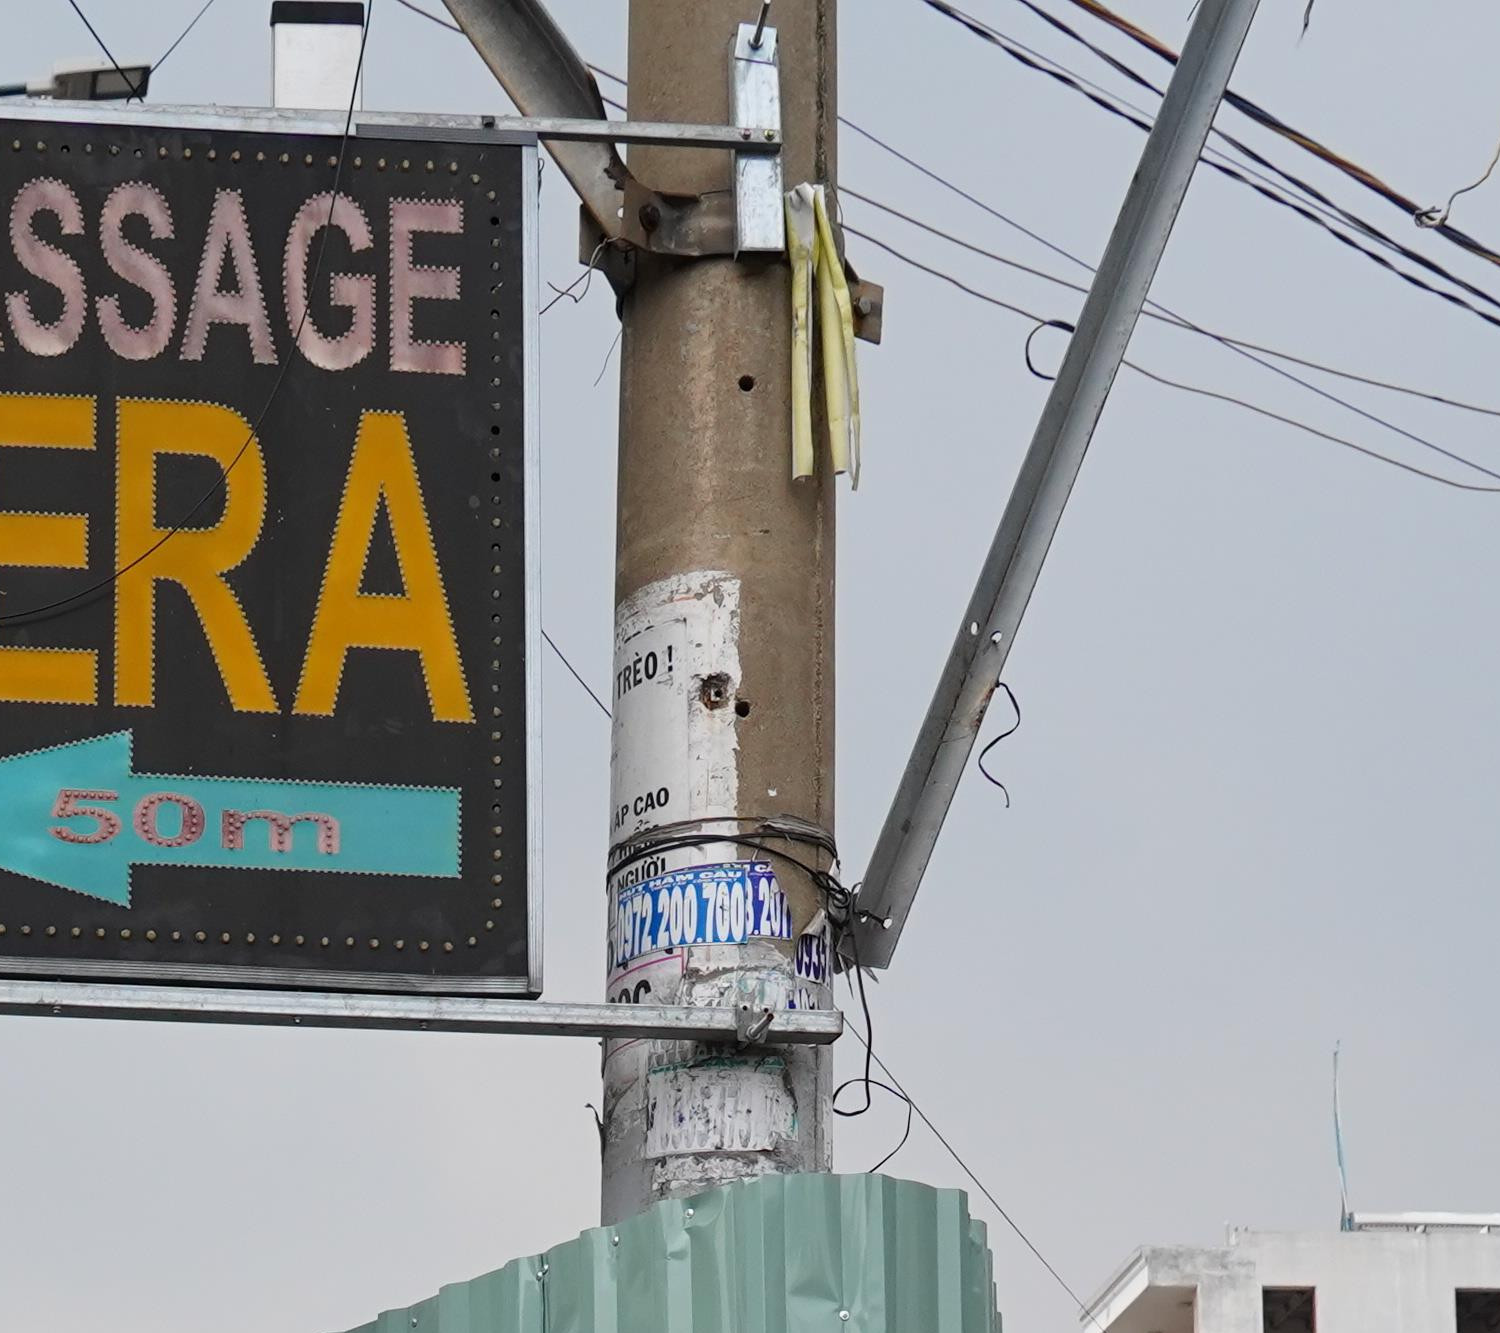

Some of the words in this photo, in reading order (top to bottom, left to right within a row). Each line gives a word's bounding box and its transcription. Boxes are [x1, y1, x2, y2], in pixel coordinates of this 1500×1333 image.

[617, 651, 658, 700] TRÈO
[46, 787, 342, 856] 50m
[633, 787, 670, 818] CAO
[616, 880, 746, 965] 0972.200.700
